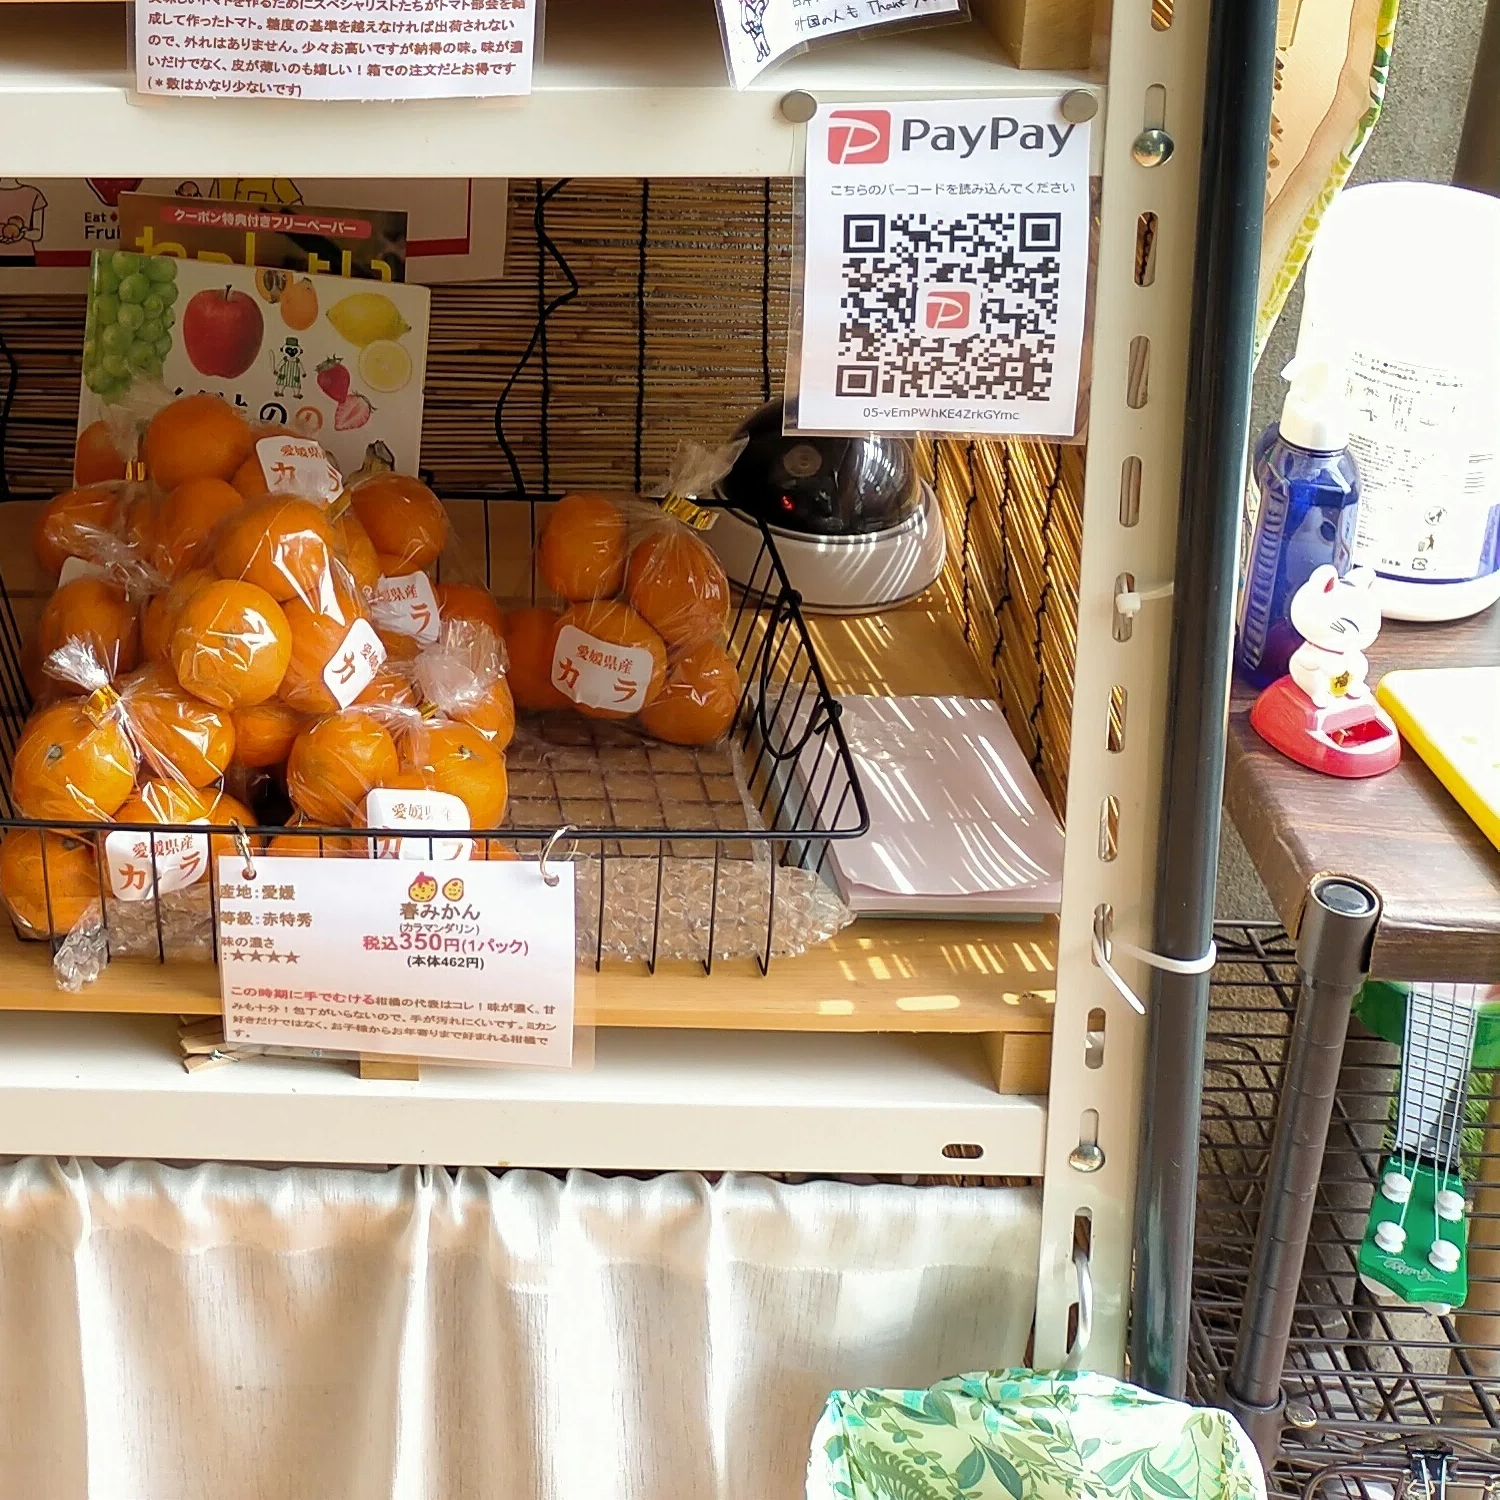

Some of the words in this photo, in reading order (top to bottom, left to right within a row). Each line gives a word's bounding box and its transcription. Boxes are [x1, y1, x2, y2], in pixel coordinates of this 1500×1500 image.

[902, 115, 1076, 159] PayPay
[830, 182, 1075, 196] こちらのバーコードを読み込んでください
[85, 212, 106, 222] Eat
[576, 644, 633, 675] 愛媛県産
[220, 884, 295, 900] 産地:愛媛
[220, 911, 312, 928] 等級:赤特秀
[400, 902, 481, 921] 春みかん
[399, 923, 480, 935] (カラマンダリン)
[221, 936, 274, 948] 味の濃さ
[362, 933, 529, 956] 税込350円(1パック)
[407, 955, 484, 970] (本体462円)
